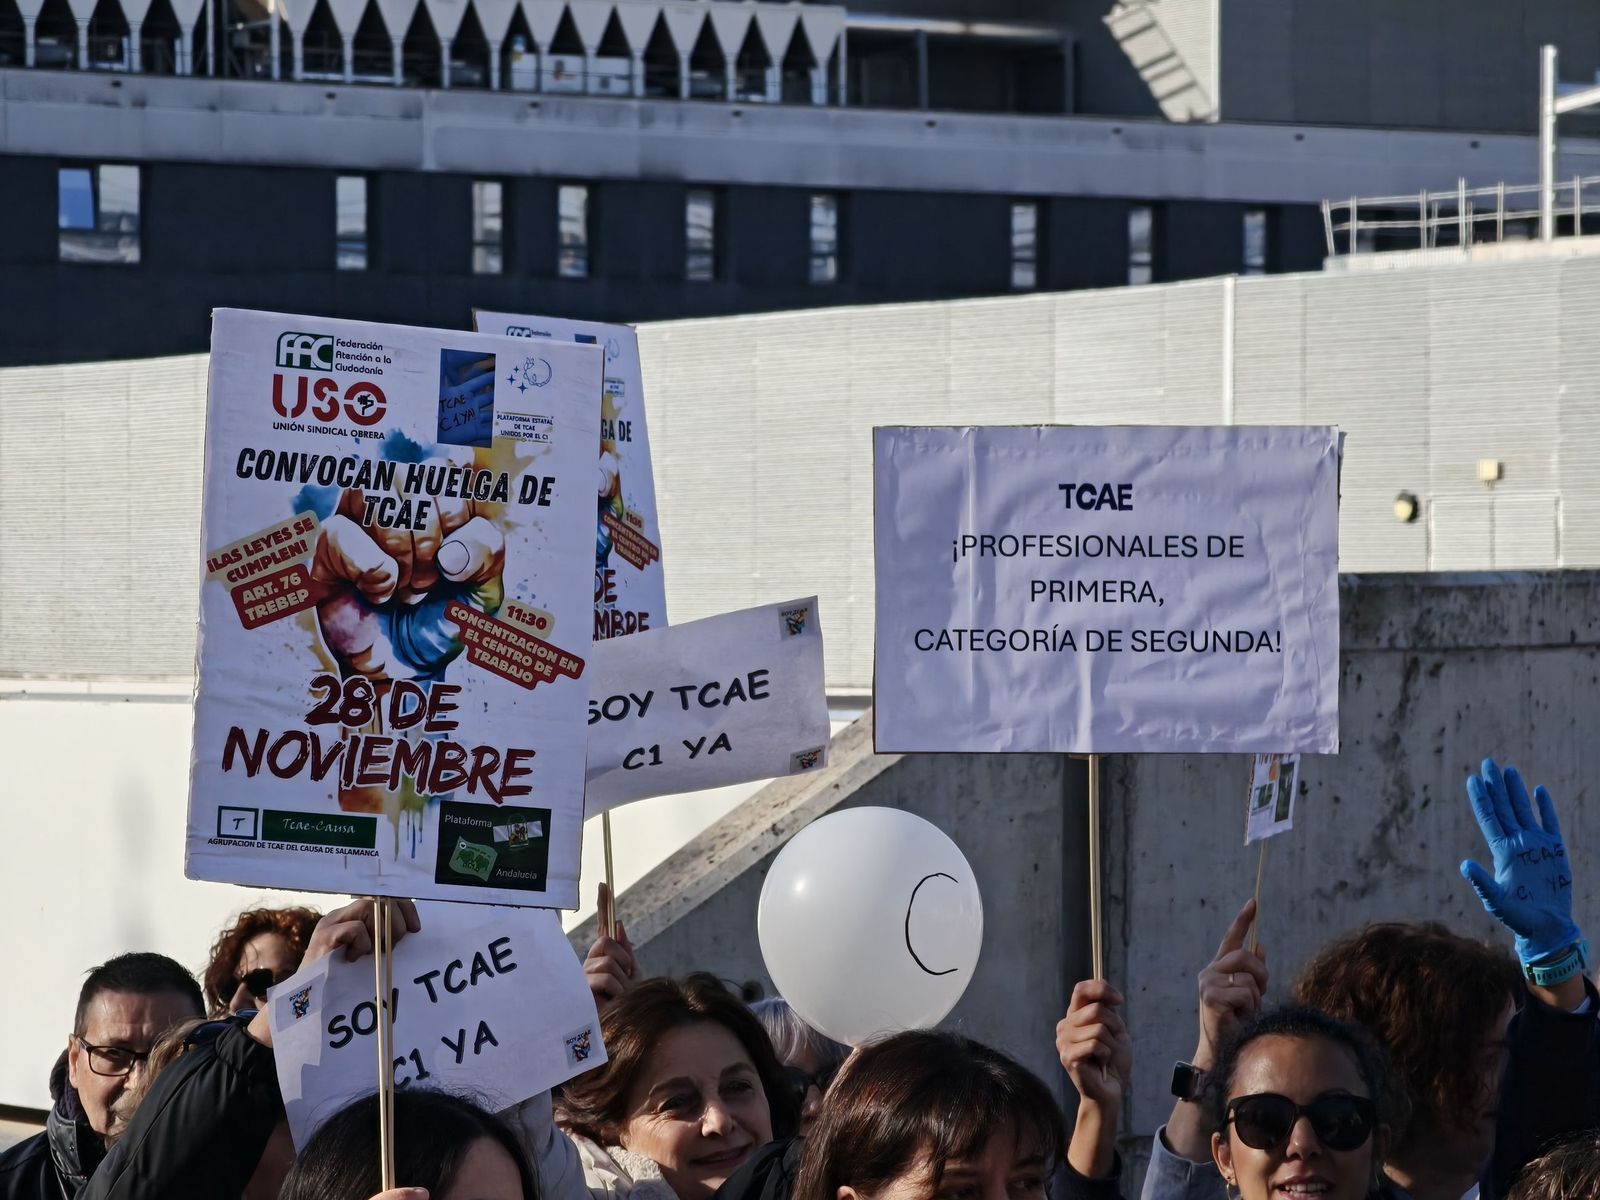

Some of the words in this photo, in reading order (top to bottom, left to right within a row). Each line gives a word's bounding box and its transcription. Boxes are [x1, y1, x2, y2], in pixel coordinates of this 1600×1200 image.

[336, 338, 383, 351] Federación
[336, 350, 373, 362] Atención
[384, 355, 392, 364] la
[335, 363, 383, 376] Ciudadanía
[272, 374, 387, 426] USO
[440, 394, 466, 412] TCAE
[273, 421, 305, 433] UNIÓN
[307, 425, 348, 437] SINDICAL
[350, 430, 385, 440] OBRERA
[497, 414, 530, 423] PLATAFORMA
[532, 417, 554, 425] ESTATAL
[500, 430, 521, 438] UNIDOS
[236, 447, 397, 491] CONVOCAN
[403, 463, 509, 503] HUELGA
[517, 475, 556, 507] DE
[361, 496, 432, 531] TCAE
[1058, 482, 1133, 512] TCAE
[206, 548, 243, 573] ¡LAS
[243, 526, 293, 557] LEYES
[292, 517, 315, 536] SE
[226, 539, 308, 583] CUMPLEN!
[952, 534, 1198, 563] ¡PROFESIONALES
[1206, 535, 1245, 558] DE
[242, 581, 279, 605] ART.
[280, 572, 302, 590] 76
[244, 588, 310, 621] TREBEP
[1030, 580, 1165, 607] PRIMERA,
[506, 604, 548, 631] 11:30
[450, 606, 559, 664] CONCENTRACION
[558, 656, 578, 673] EN
[464, 628, 480, 644] EL
[482, 636, 533, 667] CENTRO
[534, 660, 554, 677] DE
[914, 624, 1078, 652] CATEGORÍA
[1085, 629, 1123, 652] DE
[1130, 629, 1282, 653] SEGUNDA!
[473, 647, 534, 684] TRABAJO
[304, 674, 373, 727] 28
[388, 680, 462, 732] DE
[670, 669, 770, 711] TCAE
[222, 726, 536, 804] NOVIEMBRE
[622, 744, 663, 770] C1
[682, 732, 732, 760] YA
[232, 817, 246, 831] T
[282, 818, 356, 834] Tcae-Causa
[444, 814, 492, 828] Plataforma
[207, 838, 256, 848] AGRUPACION
[268, 842, 285, 850] TCAE
[286, 844, 298, 852] DEL
[300, 844, 324, 854] CAUSA
[324, 846, 334, 854] DE
[335, 848, 380, 857] SALAMANCA
[904, 872, 959, 976] C
[413, 936, 518, 1003] TCAE
[392, 1048, 430, 1089] C1
[441, 1020, 499, 1064] YA
